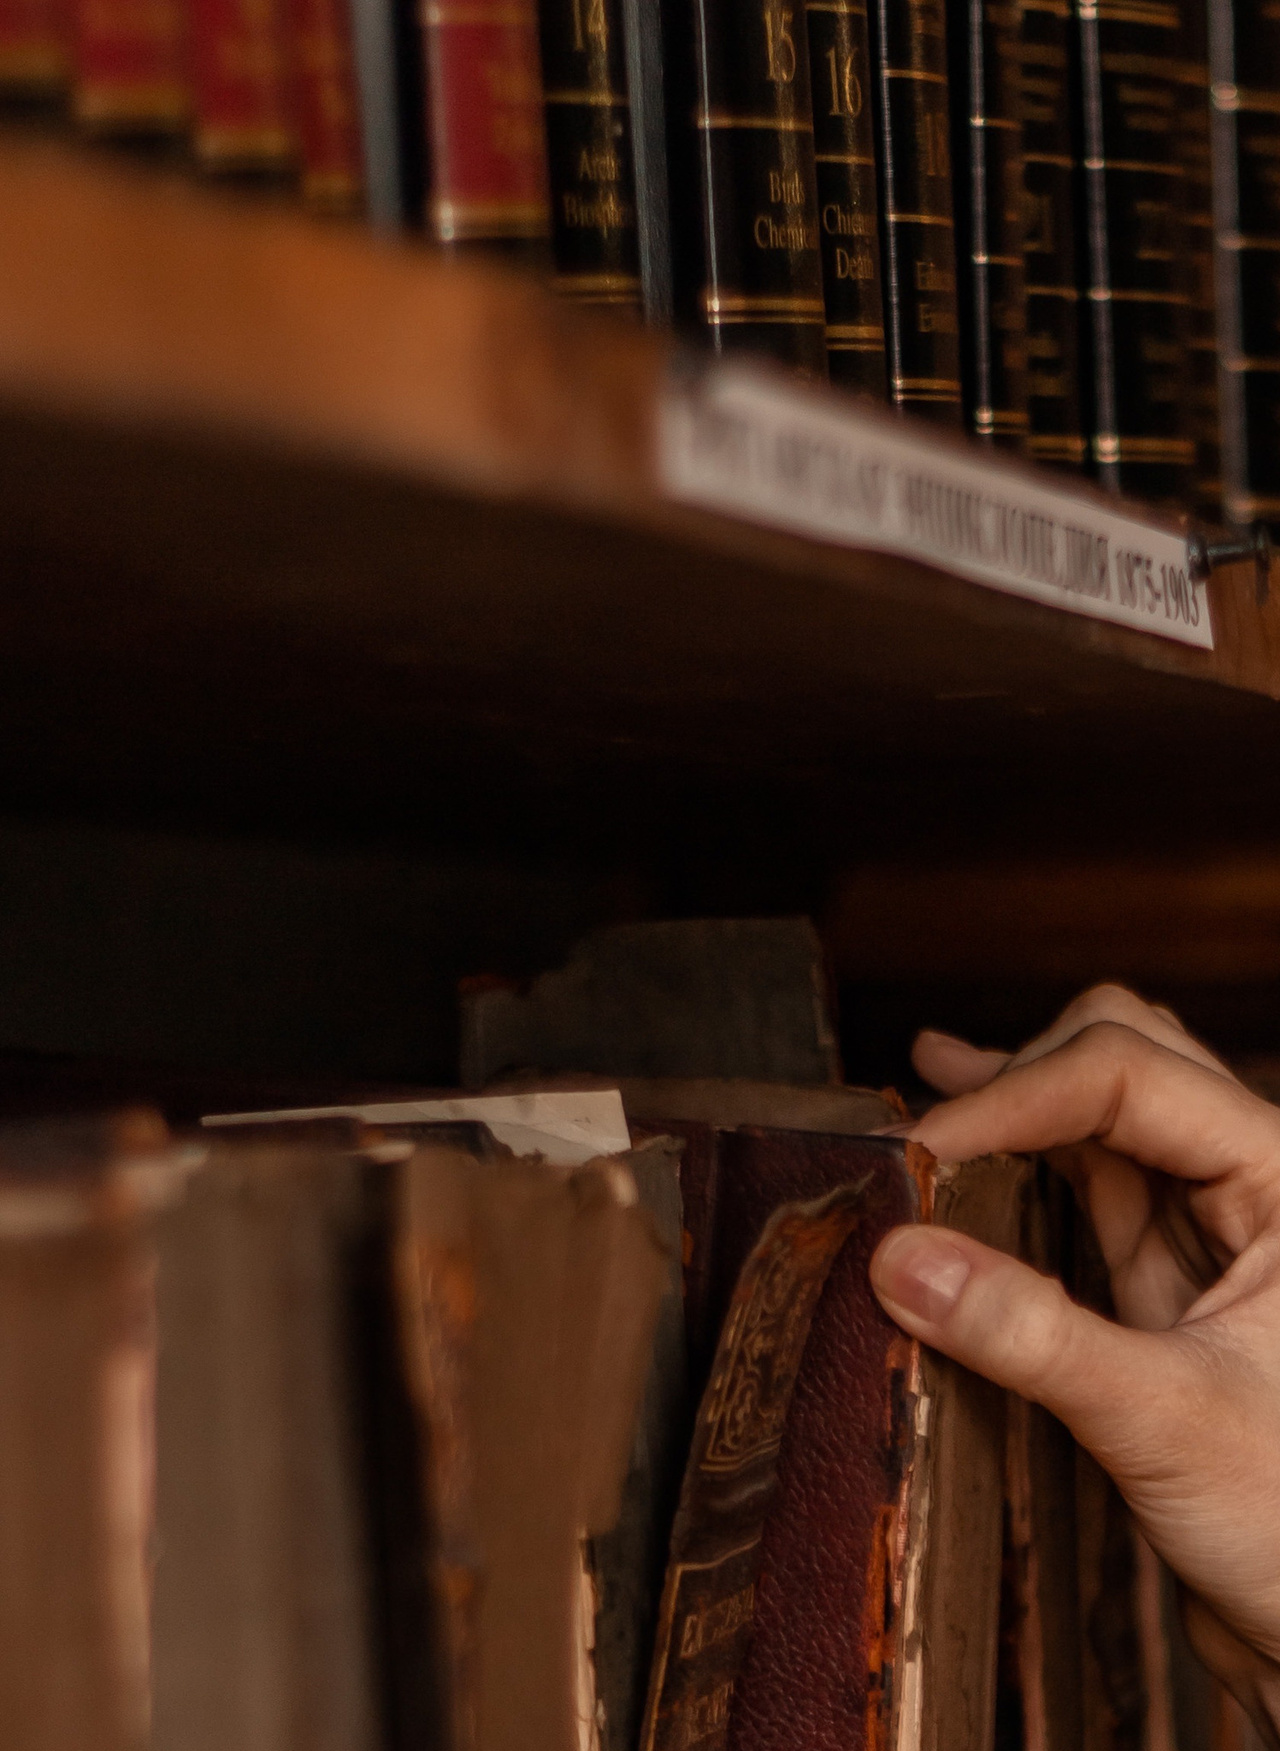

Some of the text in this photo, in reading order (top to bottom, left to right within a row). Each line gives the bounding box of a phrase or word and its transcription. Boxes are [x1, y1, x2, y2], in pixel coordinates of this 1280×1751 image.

[763, 9, 796, 83] 15
[827, 46, 862, 117] 16
[769, 169, 806, 204] Birds
[1115, 550, 1200, 627] 1875-1903
